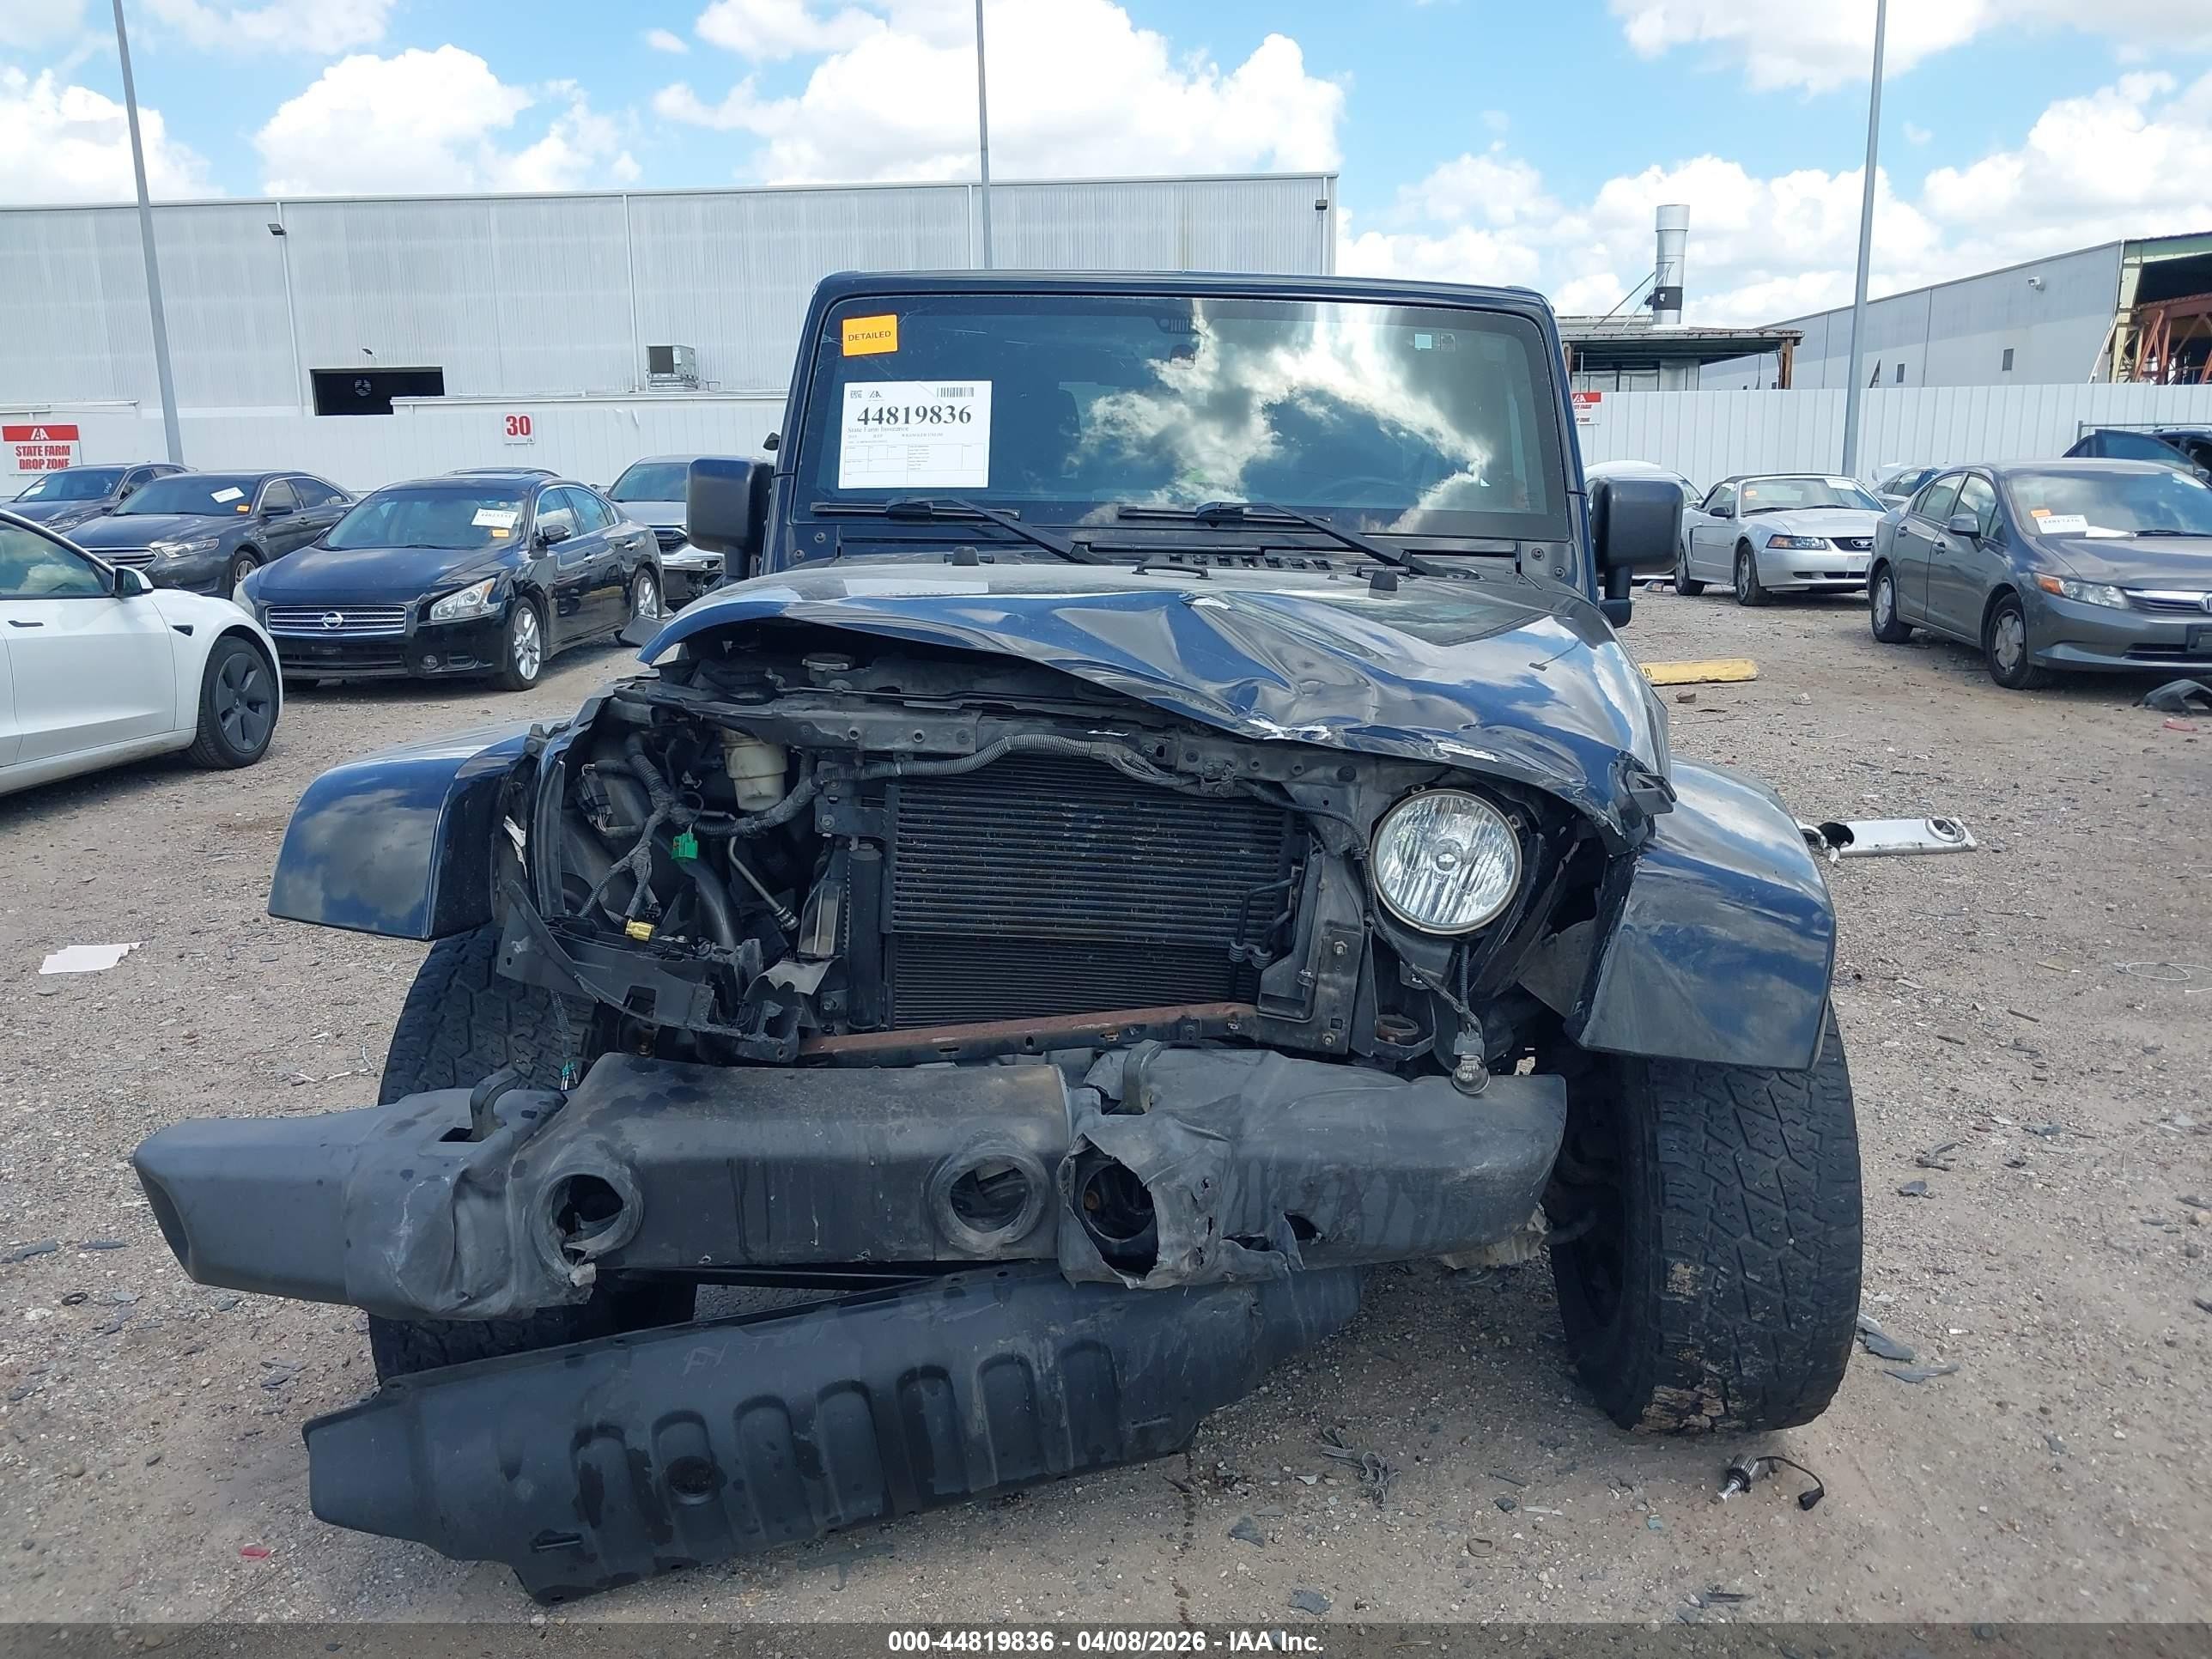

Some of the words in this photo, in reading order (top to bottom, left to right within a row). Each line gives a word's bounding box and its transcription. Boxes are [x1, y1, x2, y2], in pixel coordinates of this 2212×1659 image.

[848, 331, 891, 342] DETAILED
[857, 405, 972, 425] 44819836
[506, 416, 531, 435] 30
[15, 445, 43, 457] STATE
[45, 445, 70, 456] FARM
[19, 459, 45, 470] DROP
[46, 459, 70, 470] ZONE
